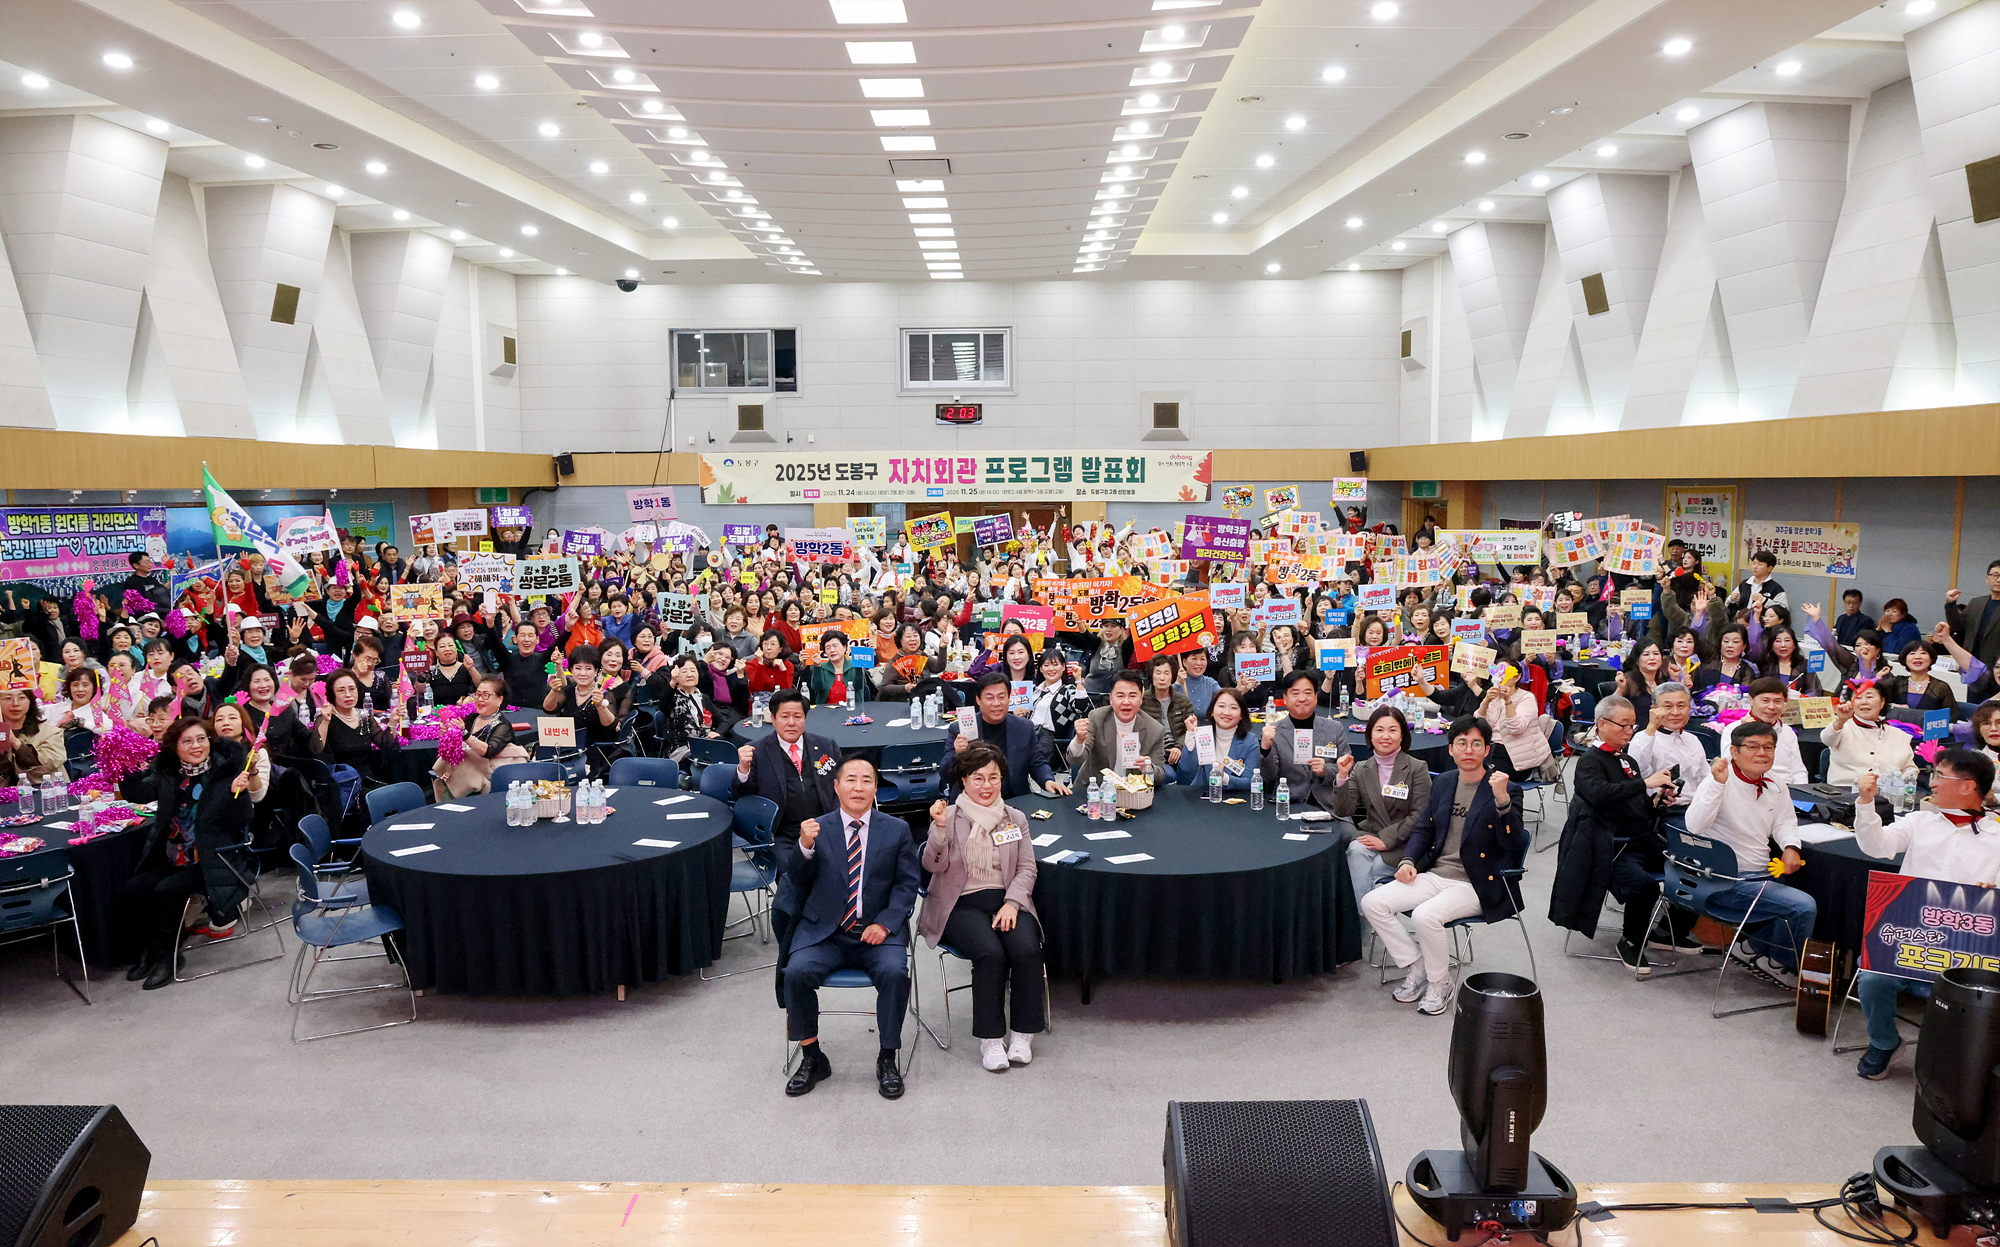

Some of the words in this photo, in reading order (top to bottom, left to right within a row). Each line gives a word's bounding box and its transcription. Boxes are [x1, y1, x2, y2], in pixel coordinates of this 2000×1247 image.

[775, 463, 831, 482] 2025년
[836, 463, 878, 482] 도봉구
[889, 457, 977, 484] 자치회관
[985, 457, 1073, 484] 프로그램
[1082, 456, 1146, 484] 발표회
[633, 496, 671, 510] 방학1동
[7, 513, 52, 535] 방학1동
[55, 513, 90, 533] 원더풀
[92, 511, 138, 532] 라인댄스!
[1554, 510, 1574, 524] 도봉
[454, 522, 482, 532] 도봉1동
[1217, 524, 1248, 536] 방학3동
[1563, 520, 1582, 532] 2동
[794, 540, 844, 556] 방학2동
[519, 573, 573, 590] 쌍문2동
[1072, 581, 1092, 591] 즐기자!
[1093, 580, 1113, 589] 이기자!
[1135, 602, 1180, 638] 진격의
[1150, 612, 1205, 653] 방학3동
[854, 653, 872, 662] 방학3동
[1322, 656, 1343, 664] 방학3동
[1380, 667, 1437, 693] 방학동
[544, 726, 570, 738] 내빈석
[1922, 906, 1995, 936] 방학3동
[1881, 924, 1947, 946] 슈퍼스타
